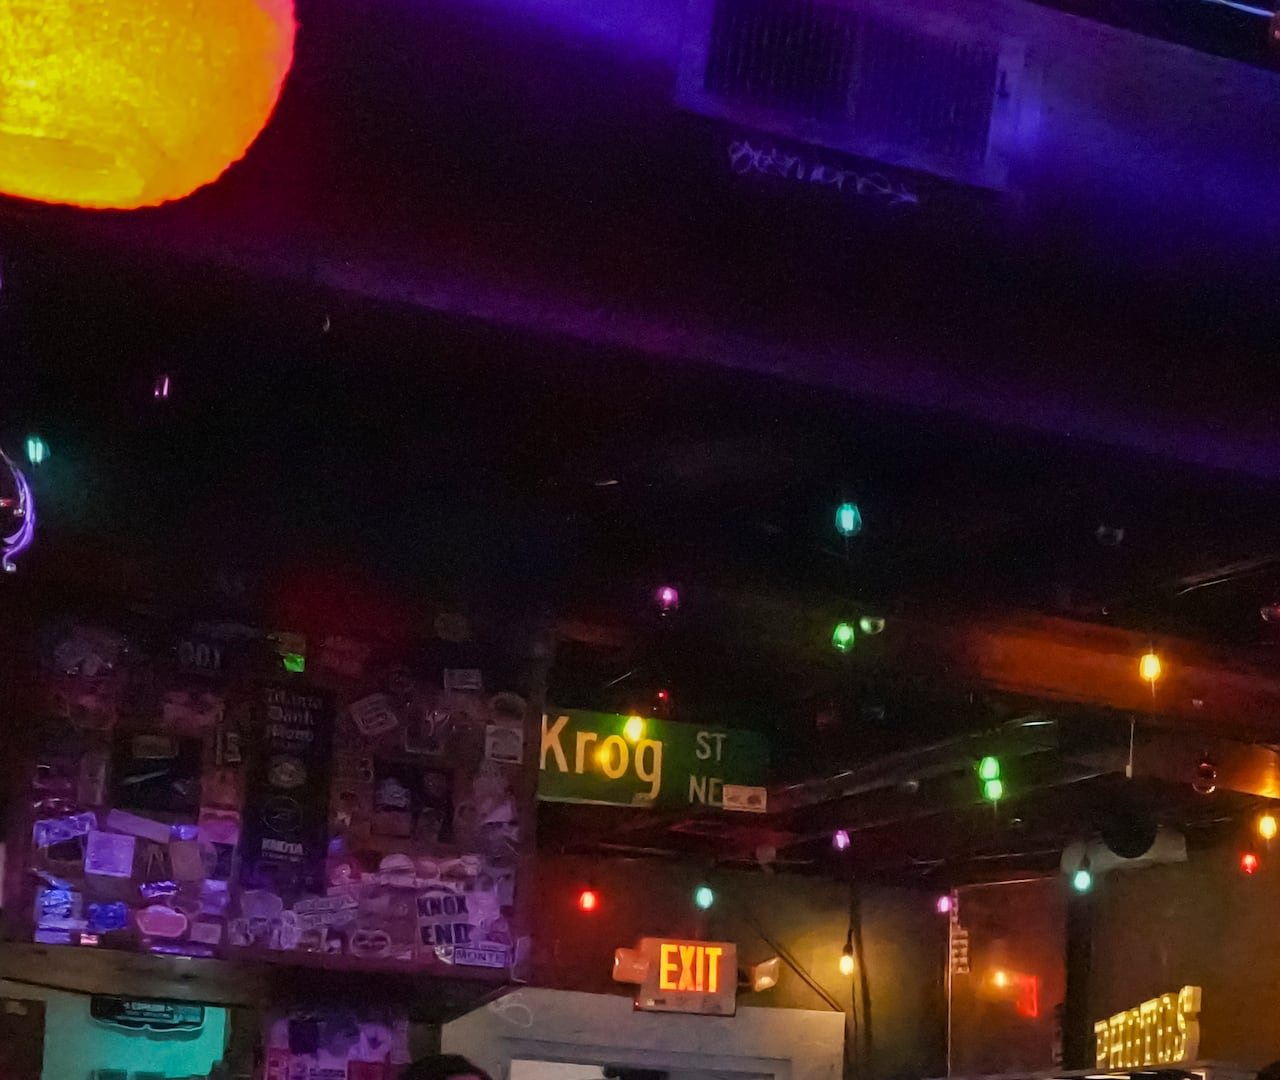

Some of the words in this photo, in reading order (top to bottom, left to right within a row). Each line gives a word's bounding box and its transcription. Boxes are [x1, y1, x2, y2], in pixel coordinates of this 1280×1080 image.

[540, 714, 663, 805] Krog
[696, 731, 728, 761] ST
[688, 775, 723, 808] NE
[660, 944, 722, 993] EXIT
